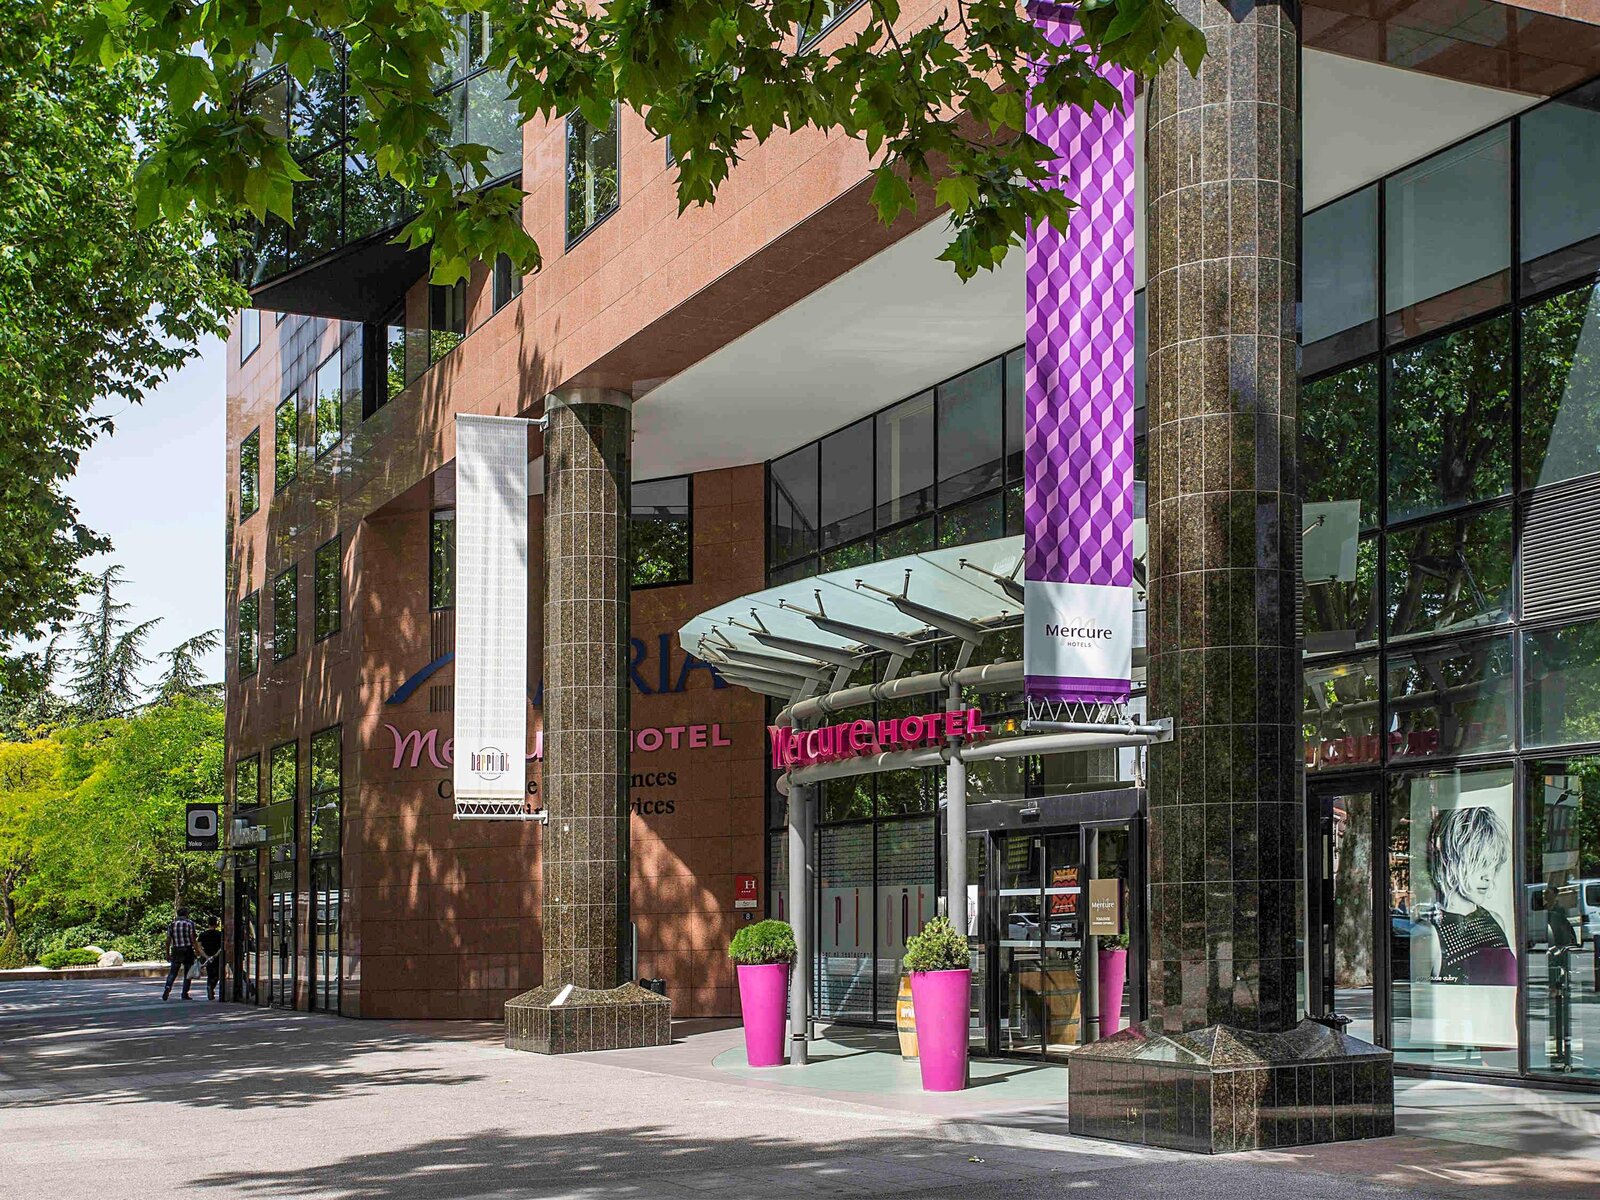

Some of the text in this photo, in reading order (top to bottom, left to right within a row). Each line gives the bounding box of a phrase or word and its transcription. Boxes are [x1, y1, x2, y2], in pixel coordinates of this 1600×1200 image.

[1045, 623, 1113, 640] Mercure
[630, 723, 732, 752] OTEL
[767, 707, 989, 770] Mercure HOTEL
[744, 880, 755, 889] H
